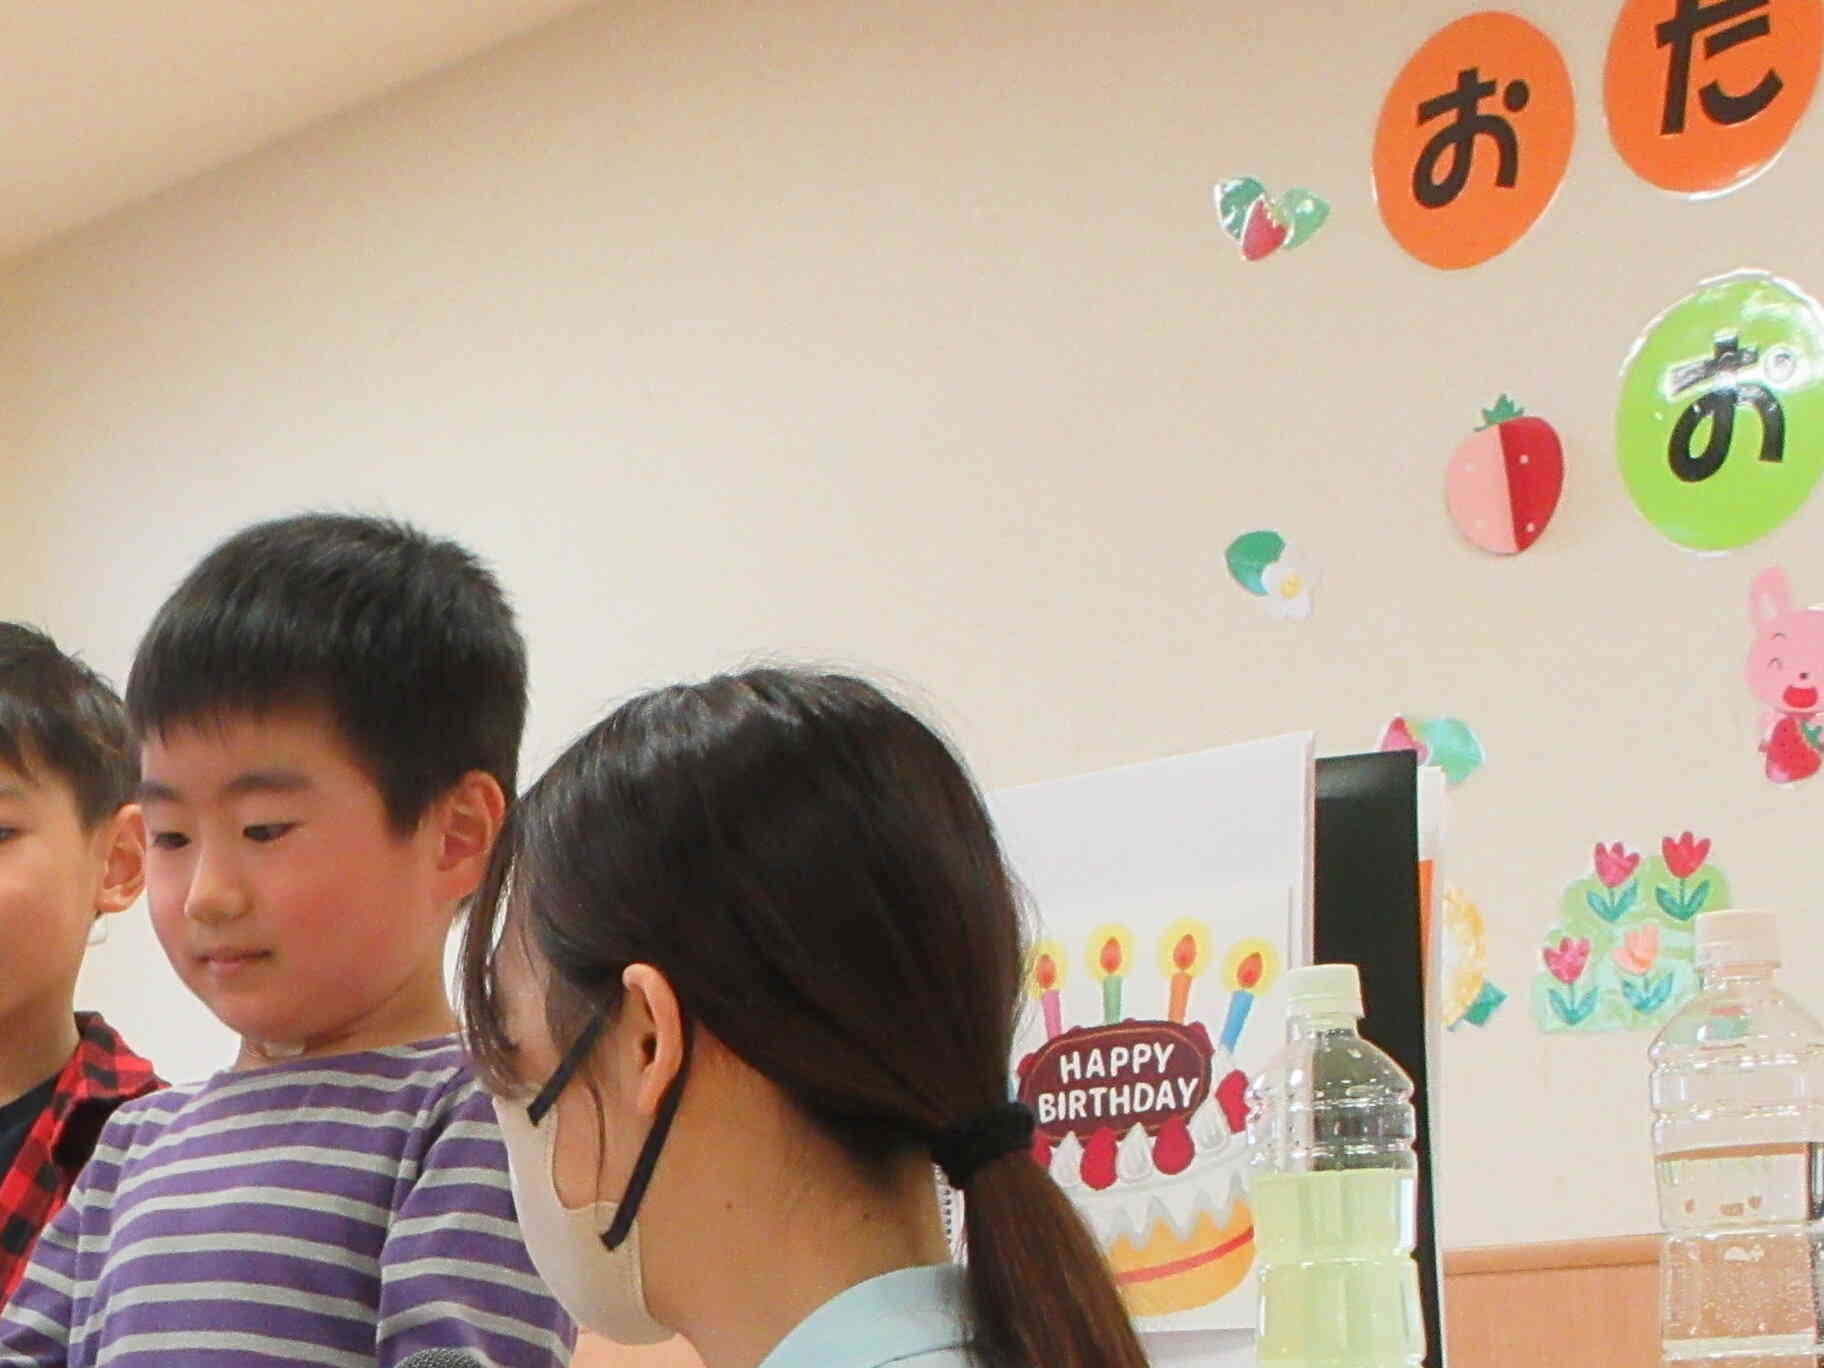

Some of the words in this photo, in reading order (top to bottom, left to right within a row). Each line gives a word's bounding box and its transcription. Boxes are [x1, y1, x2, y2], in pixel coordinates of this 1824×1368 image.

[1666, 331, 1798, 483] お
[1060, 1043, 1175, 1084] HAPPY
[1038, 1077, 1199, 1124] BIRTHDAY
